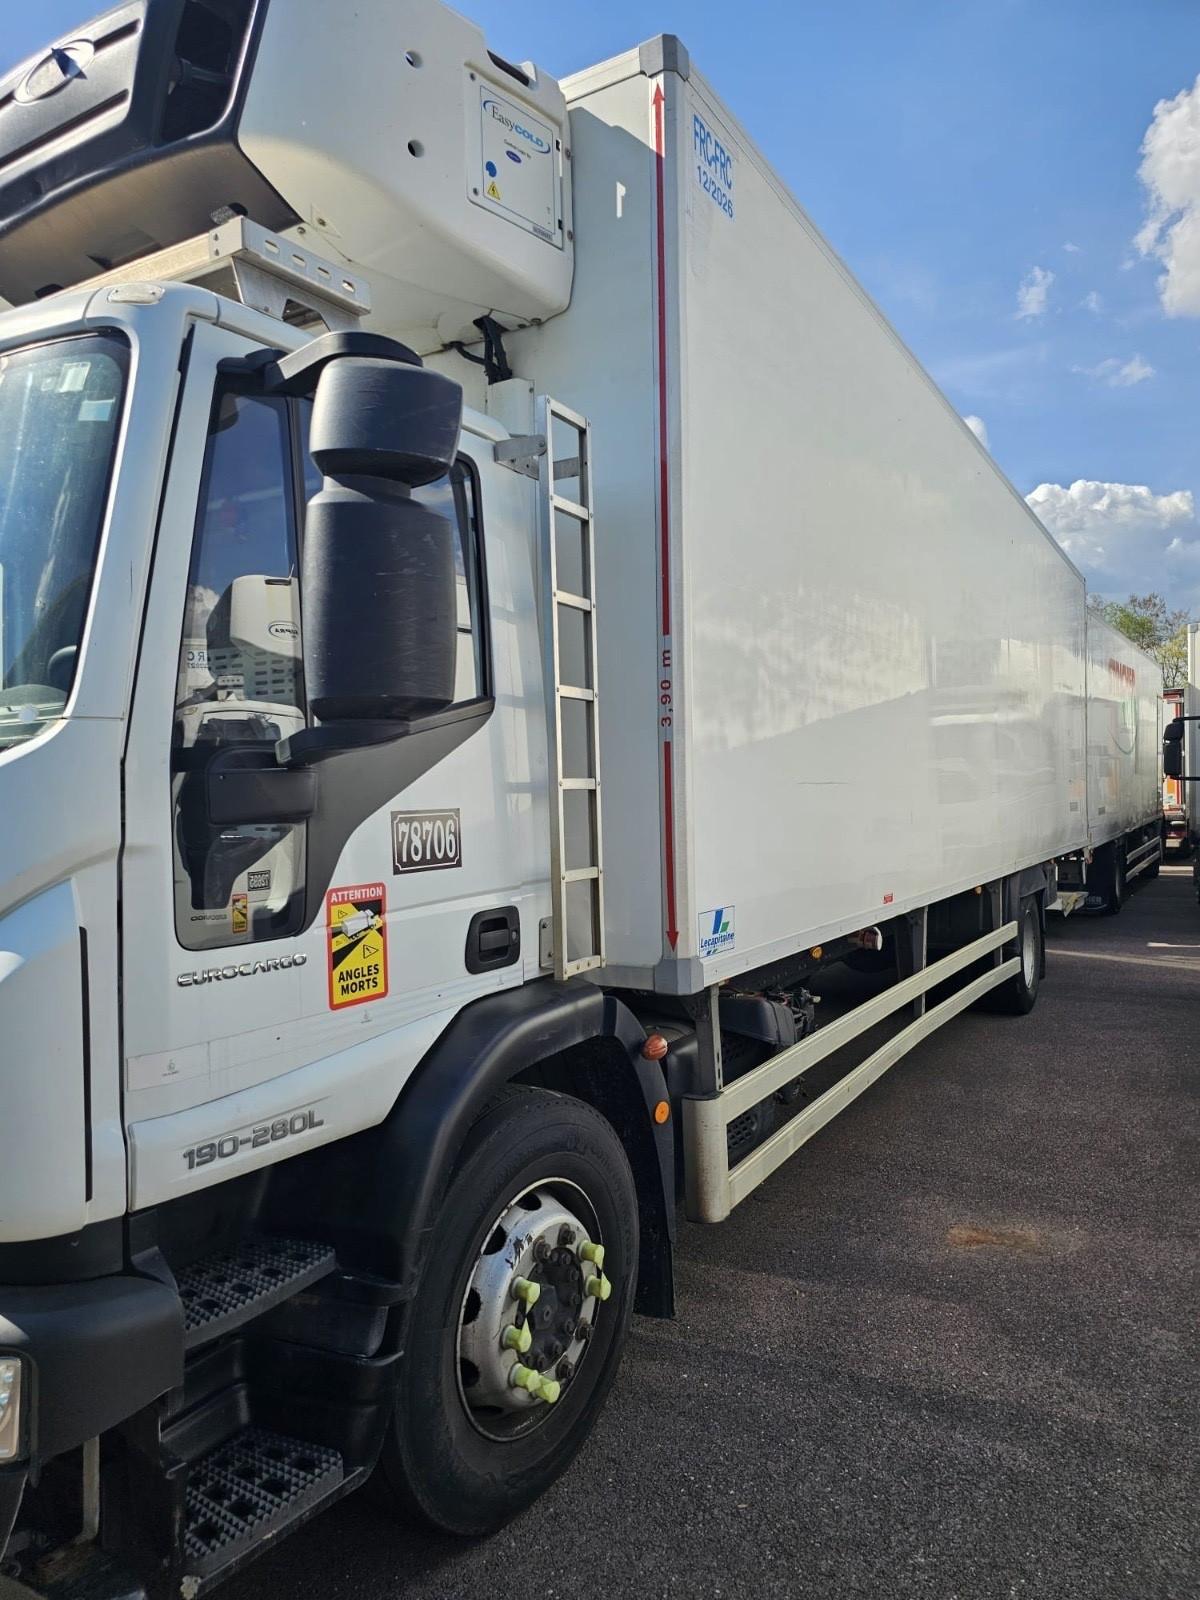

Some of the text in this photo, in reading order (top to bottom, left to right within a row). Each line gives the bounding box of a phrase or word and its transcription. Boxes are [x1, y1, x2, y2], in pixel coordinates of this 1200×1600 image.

[492, 104, 544, 148] EasyCOLD
[697, 165, 734, 218] 12/2026
[662, 649, 671, 668] m
[398, 819, 456, 863] 78706
[330, 886, 383, 904] ATTENTION
[177, 953, 307, 987] EUROCARGO
[338, 963, 380, 983] ANGLES
[340, 976, 378, 996] MORTS
[183, 1110, 324, 1170] 190-280L
